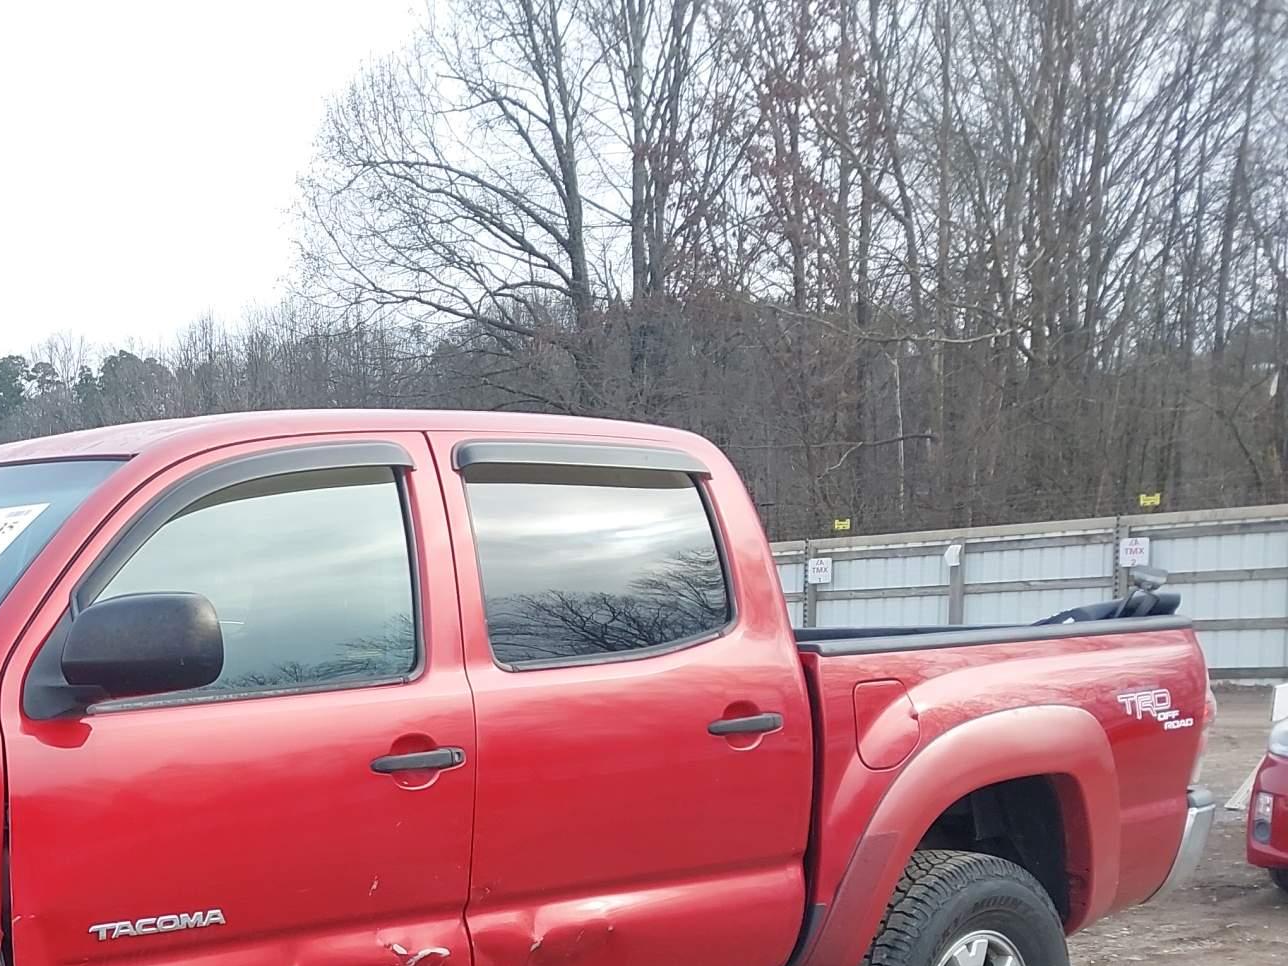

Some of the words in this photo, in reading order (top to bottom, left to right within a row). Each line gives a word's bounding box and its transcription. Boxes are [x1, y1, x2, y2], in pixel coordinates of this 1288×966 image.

[1116, 688, 1172, 720] TRD
[1156, 710, 1180, 721] OFF
[1164, 718, 1194, 730] ROAD
[88, 909, 227, 941] TACOMA
